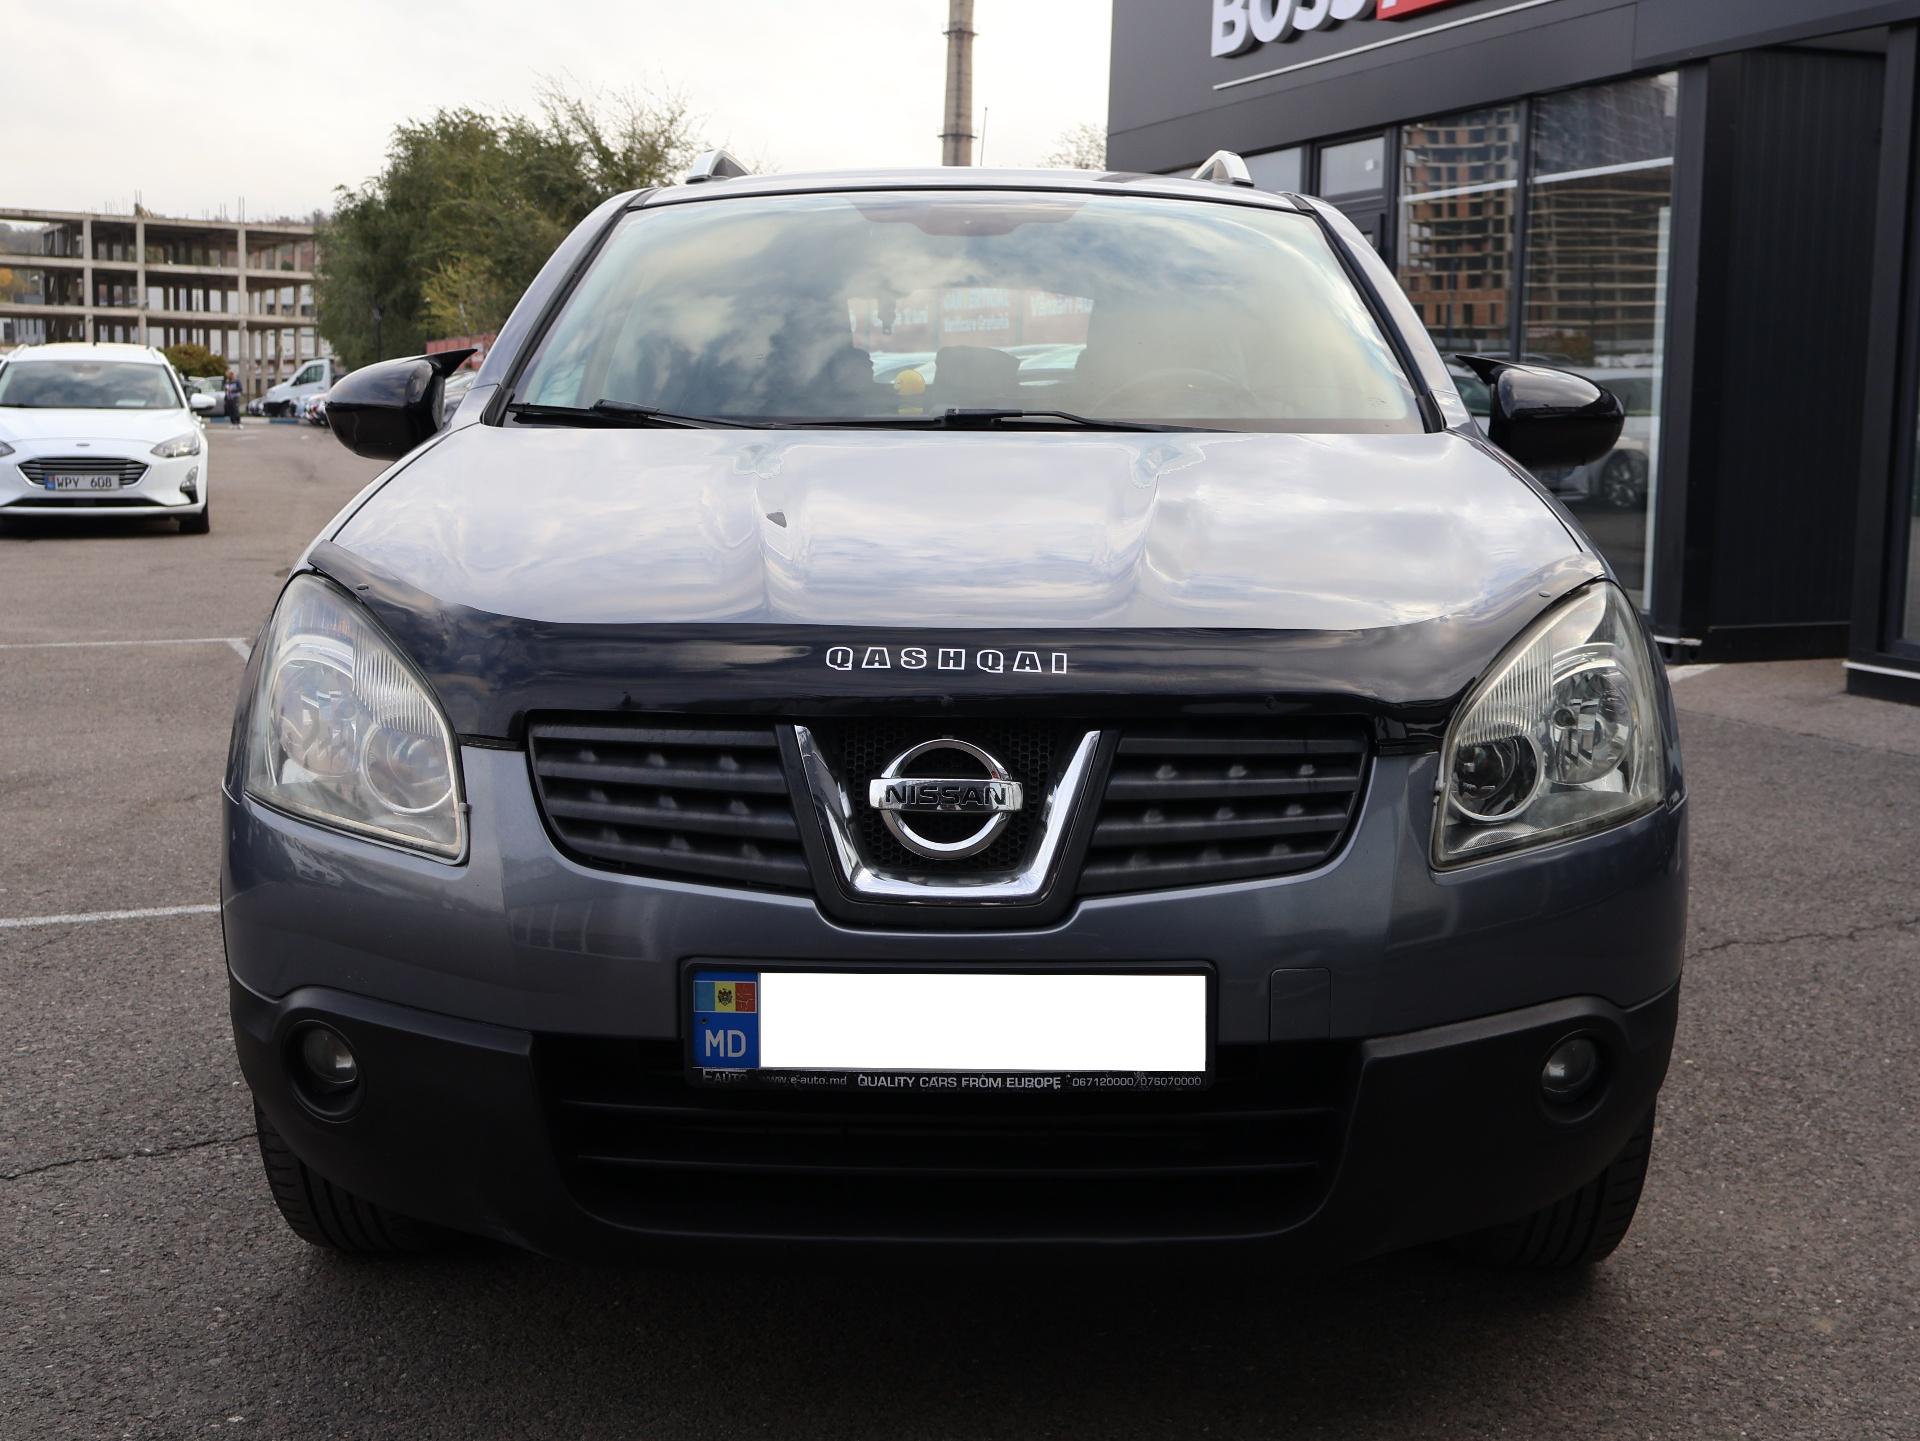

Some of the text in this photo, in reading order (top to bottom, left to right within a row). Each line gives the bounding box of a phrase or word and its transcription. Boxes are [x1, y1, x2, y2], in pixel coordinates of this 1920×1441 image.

[1211, 0, 1370, 57] BO
[826, 646, 1067, 674] QASHQAI
[885, 784, 1007, 806] NISSAN
[705, 1029, 747, 1057] MD
[858, 1075, 915, 1088] QUALITY
[919, 1076, 958, 1088] CARS
[961, 1076, 1002, 1088] FROM
[1006, 1076, 1061, 1089] EUROPE
